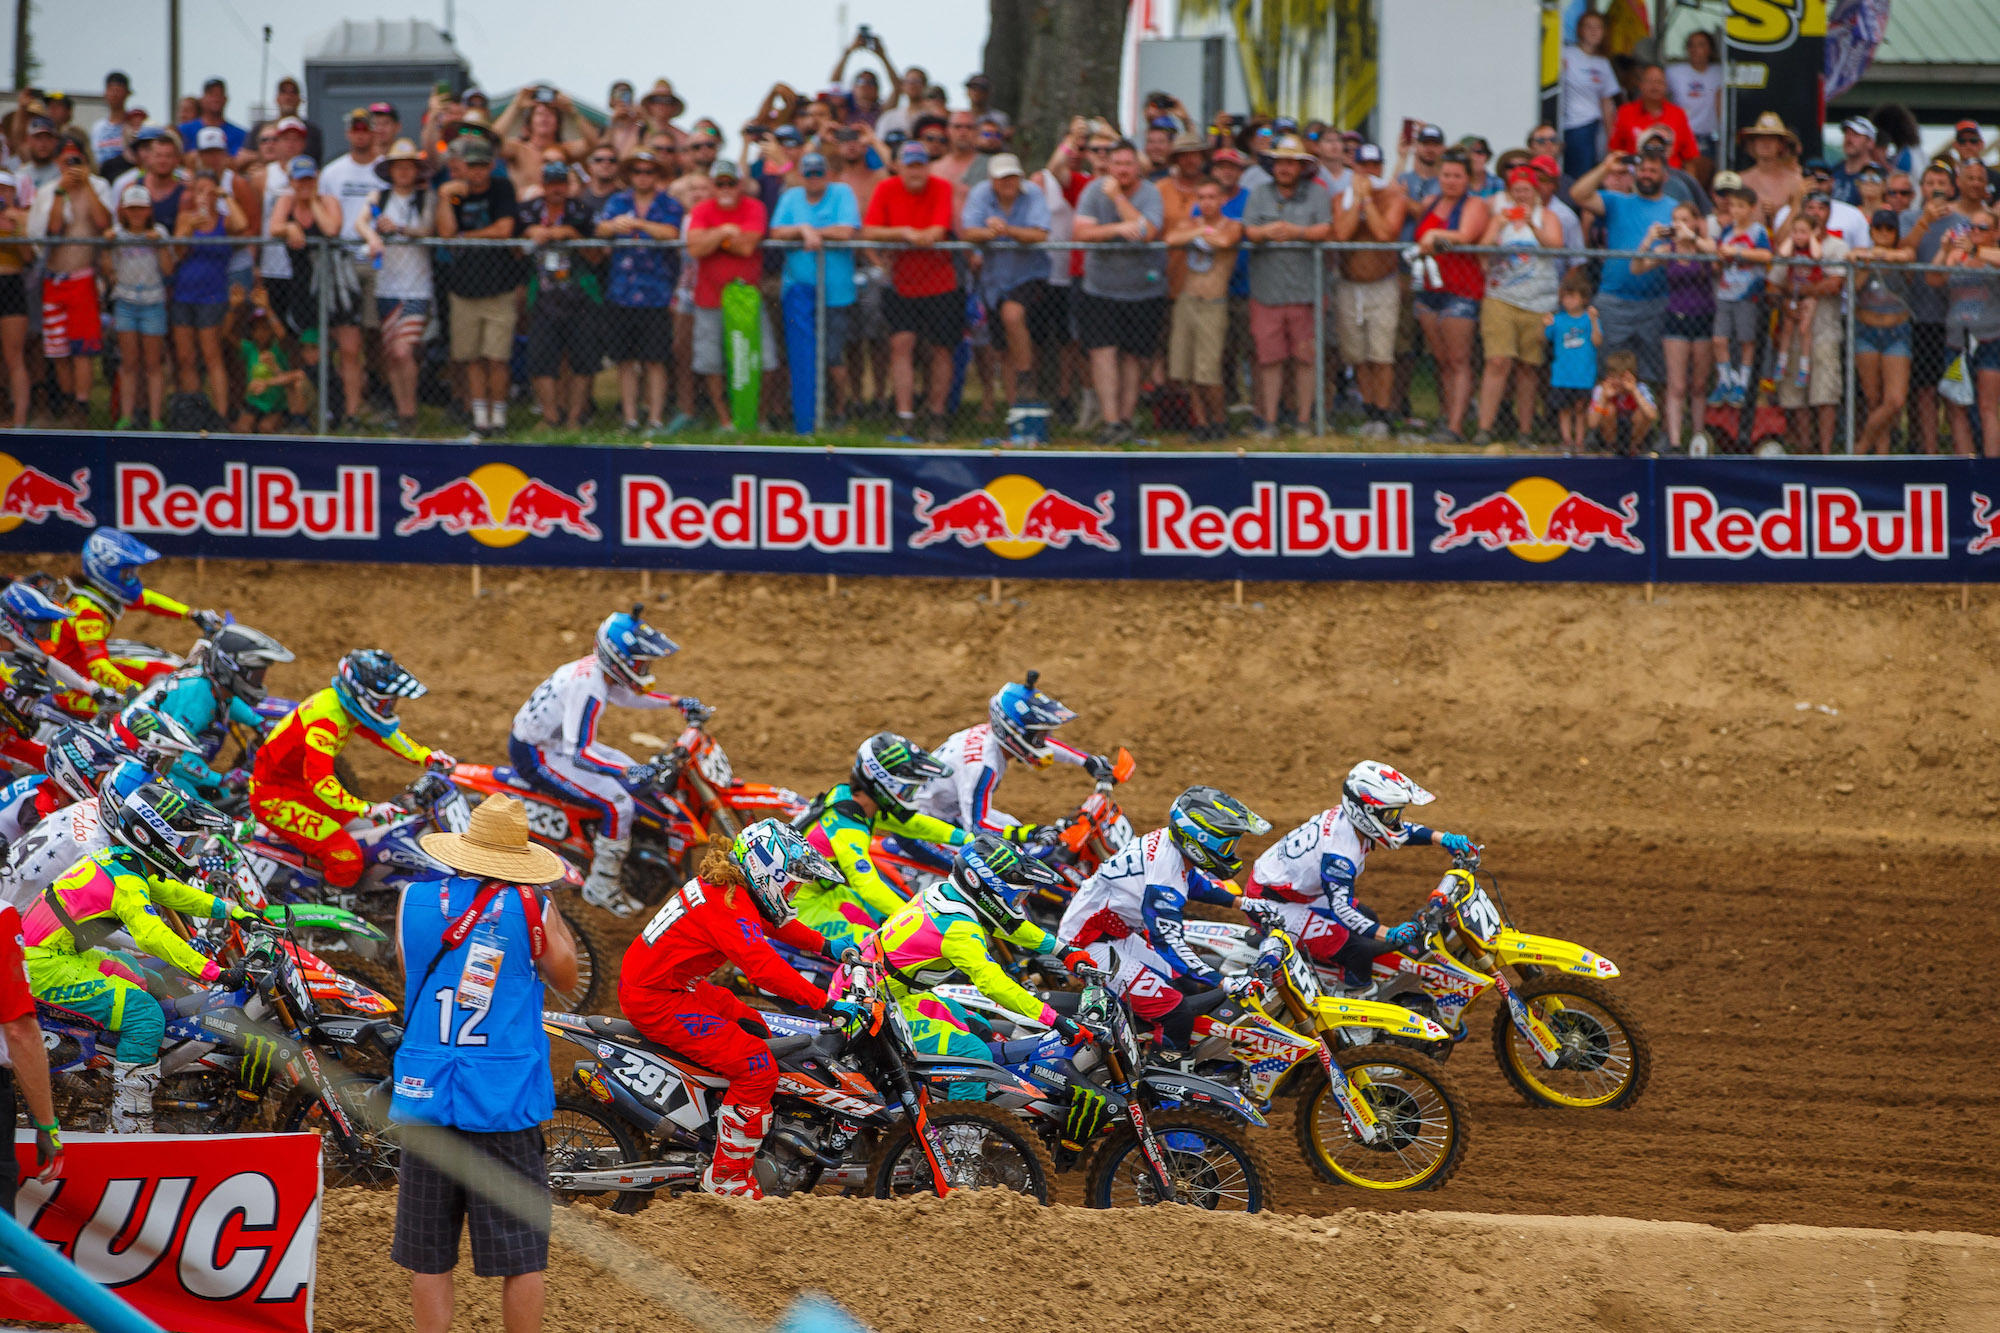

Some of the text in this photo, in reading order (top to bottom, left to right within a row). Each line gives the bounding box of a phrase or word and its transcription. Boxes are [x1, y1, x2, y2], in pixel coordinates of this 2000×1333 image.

[136, 802, 177, 843] 100%
[965, 851, 1004, 893] 100%
[966, 871, 977, 885] BELL
[453, 909, 478, 940] Canon
[641, 890, 688, 946] 91
[532, 926, 543, 956] Canon
[42, 978, 107, 1002] THOR
[1400, 958, 1475, 997] SUZUKI
[204, 1015, 238, 1035] YAMALUBE
[435, 987, 488, 1047] 12
[1251, 1015, 1272, 1028] JGR
[1397, 1026, 1422, 1035] JGR
[1208, 1021, 1299, 1062] SUZUKI
[1532, 1025, 1554, 1050] PIRELLI
[747, 1051, 769, 1071] FLY
[1033, 1063, 1068, 1086] YAMALUBE
[613, 1052, 682, 1106] 291
[1352, 1097, 1372, 1125] PIRELLI
